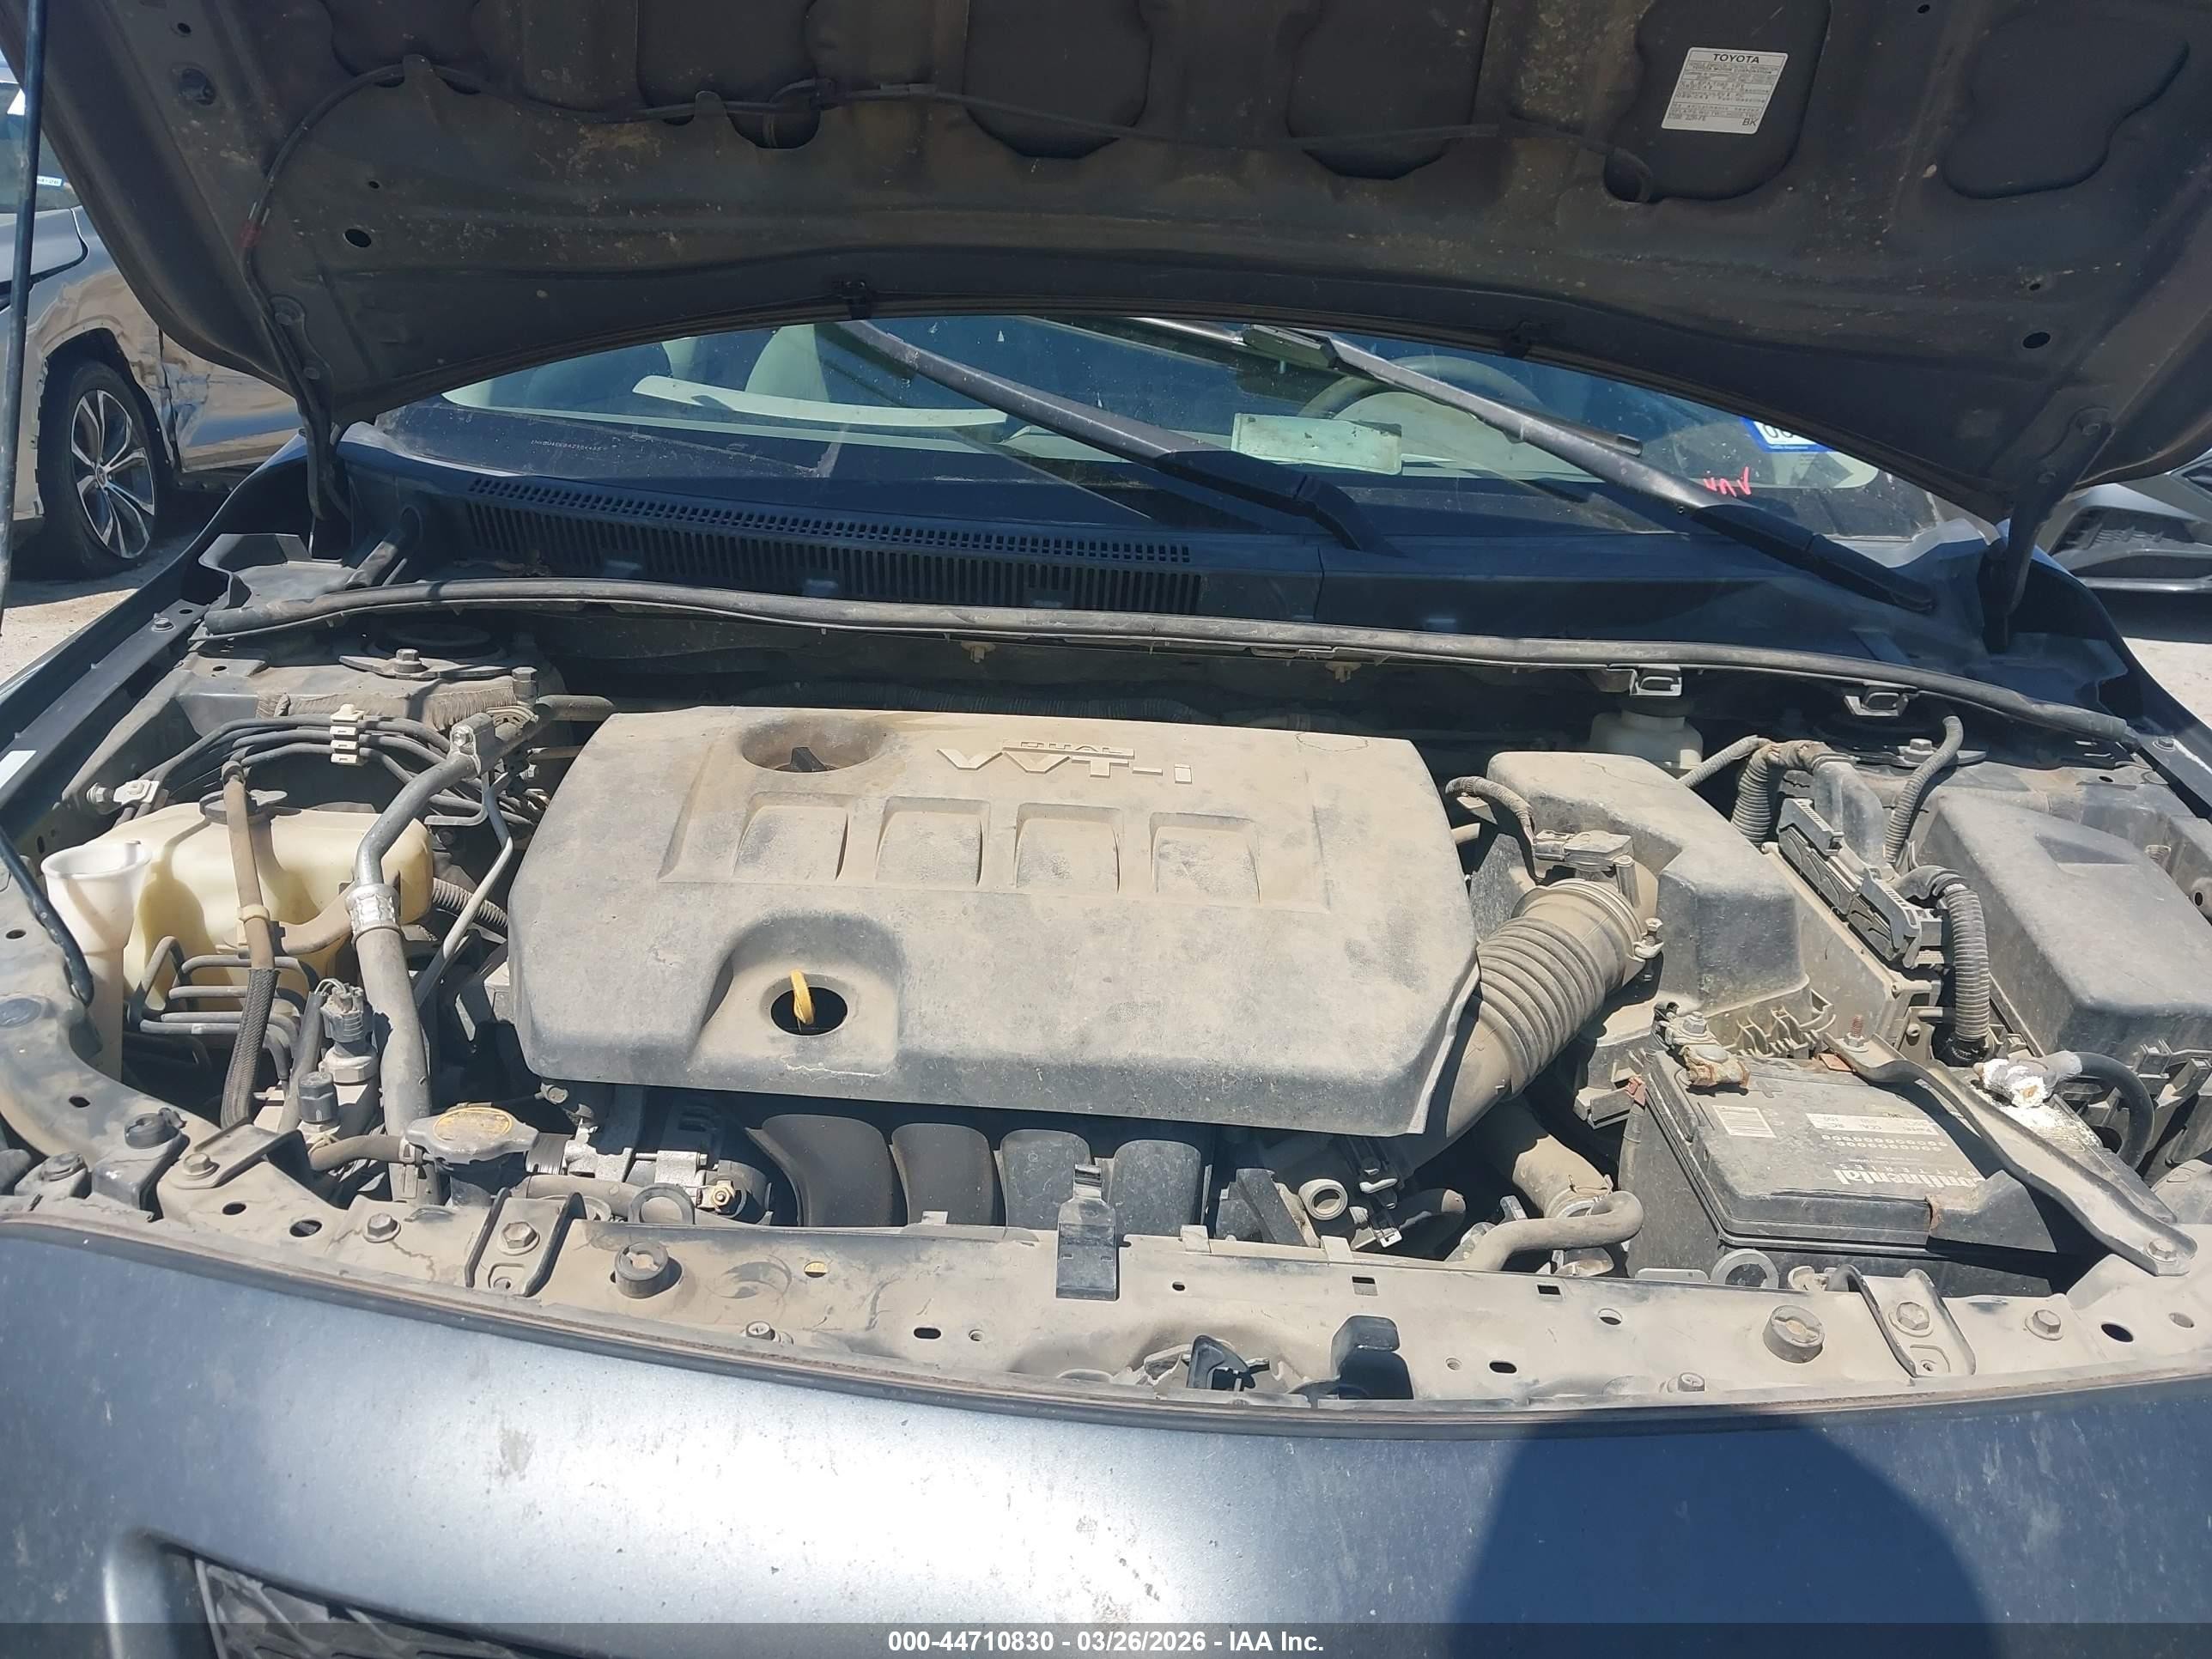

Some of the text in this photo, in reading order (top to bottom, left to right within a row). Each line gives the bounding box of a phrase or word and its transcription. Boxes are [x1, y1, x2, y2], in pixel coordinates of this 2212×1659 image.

[1713, 53, 1759, 64] TOYOTA
[1742, 118, 1759, 126] BK
[936, 748, 1192, 783] VVT-i
